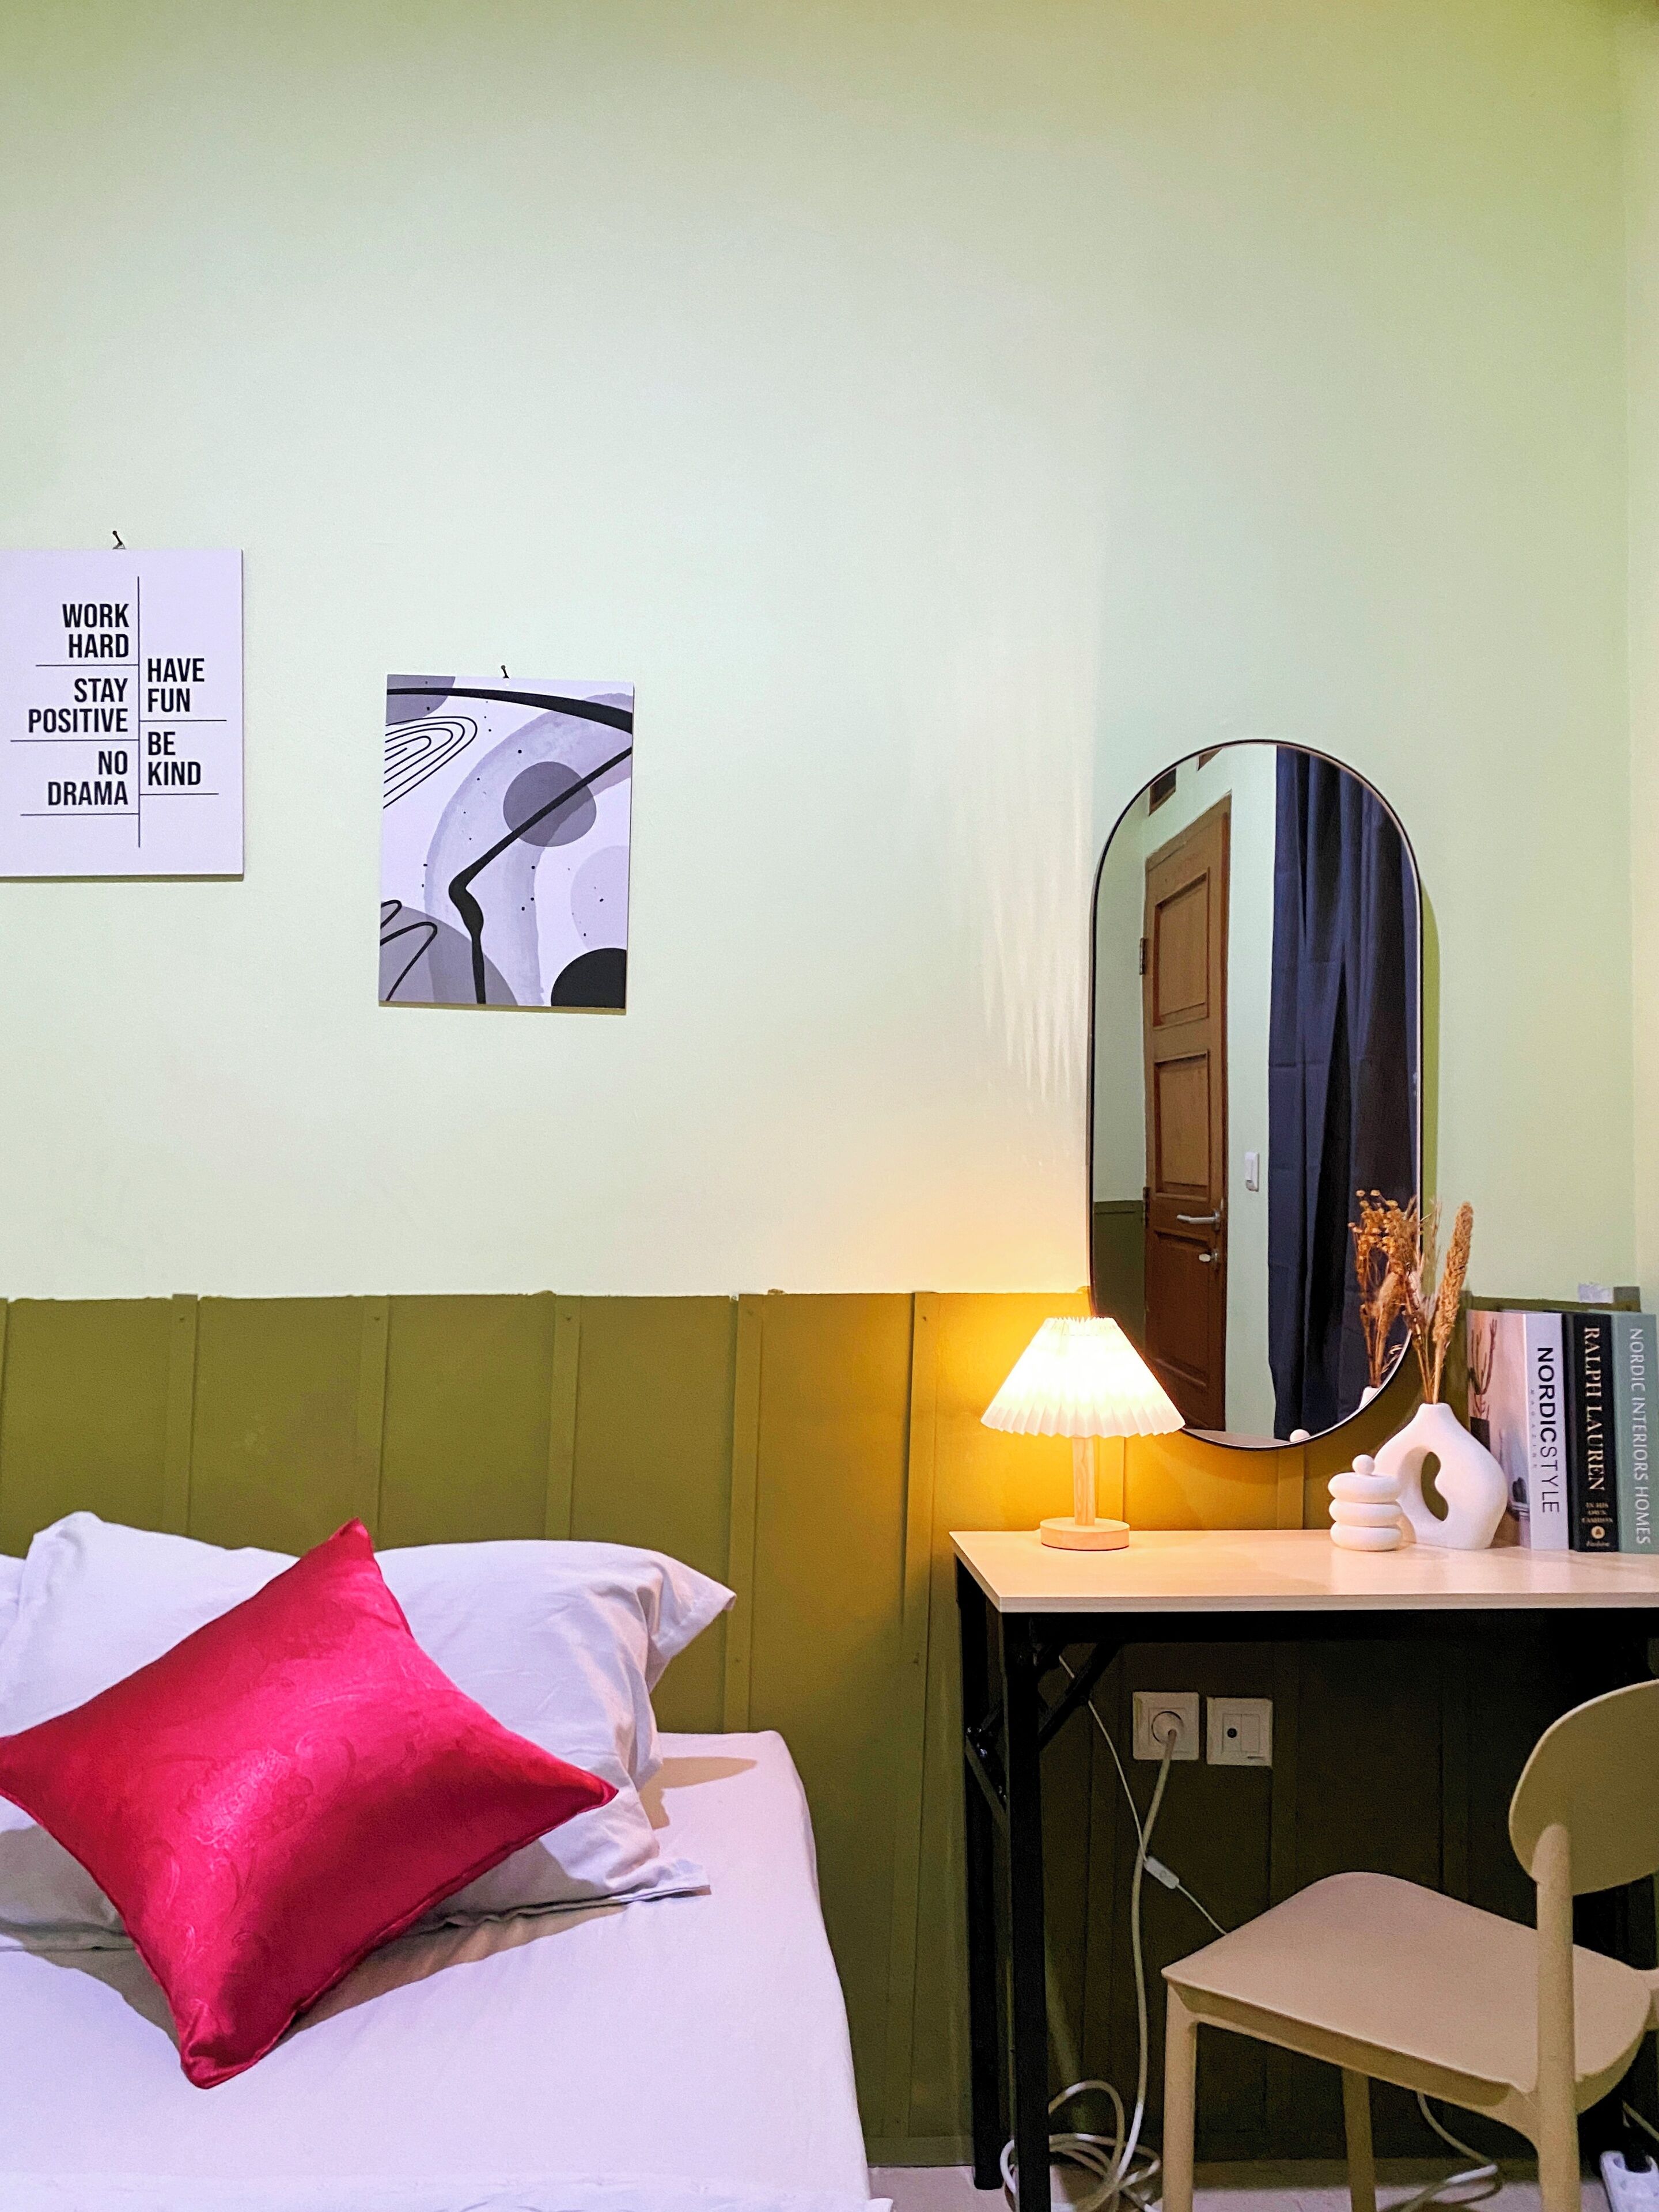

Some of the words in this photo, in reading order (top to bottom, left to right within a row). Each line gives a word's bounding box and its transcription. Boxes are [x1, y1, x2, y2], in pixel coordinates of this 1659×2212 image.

[62, 603, 130, 628] WORK
[69, 634, 129, 658] HARD
[147, 658, 205, 683] HAVE
[74, 677, 128, 703] STAY
[147, 688, 190, 713] FUN
[28, 708, 128, 733] POSITIVE
[147, 731, 176, 756] BE
[98, 750, 128, 775] NO
[148, 761, 201, 786] KIND
[48, 781, 128, 806] DRAMA
[1584, 1327, 1602, 1397] RALPH
[1630, 1328, 1645, 1392] NORDIC
[1586, 1406, 1605, 1491] LAUREN
[1633, 1397, 1648, 1481] INTERIORS
[1635, 1486, 1651, 1545] HOMES
